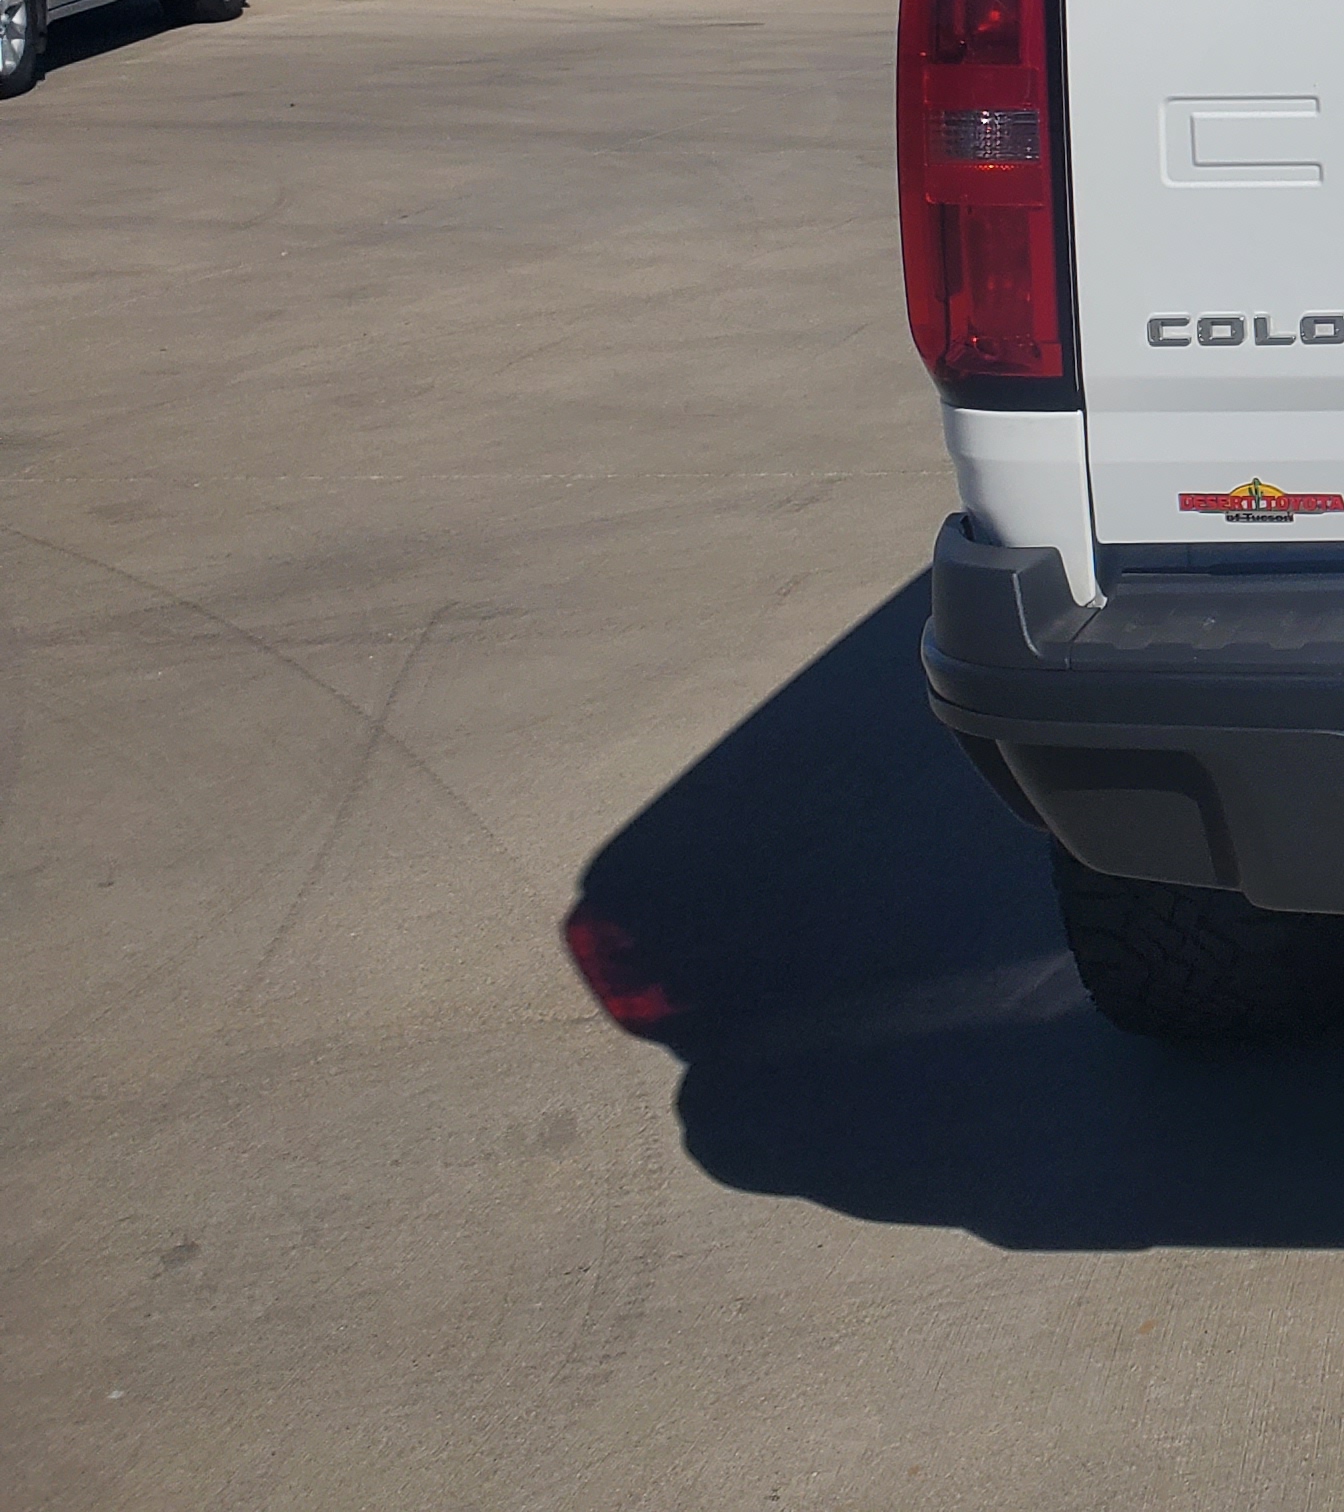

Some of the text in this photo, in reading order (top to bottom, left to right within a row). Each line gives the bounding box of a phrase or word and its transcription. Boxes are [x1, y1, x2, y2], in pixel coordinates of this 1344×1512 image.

[1180, 495, 1344, 510] DESERT TOYOTA
[1226, 511, 1294, 522] of Tucson
